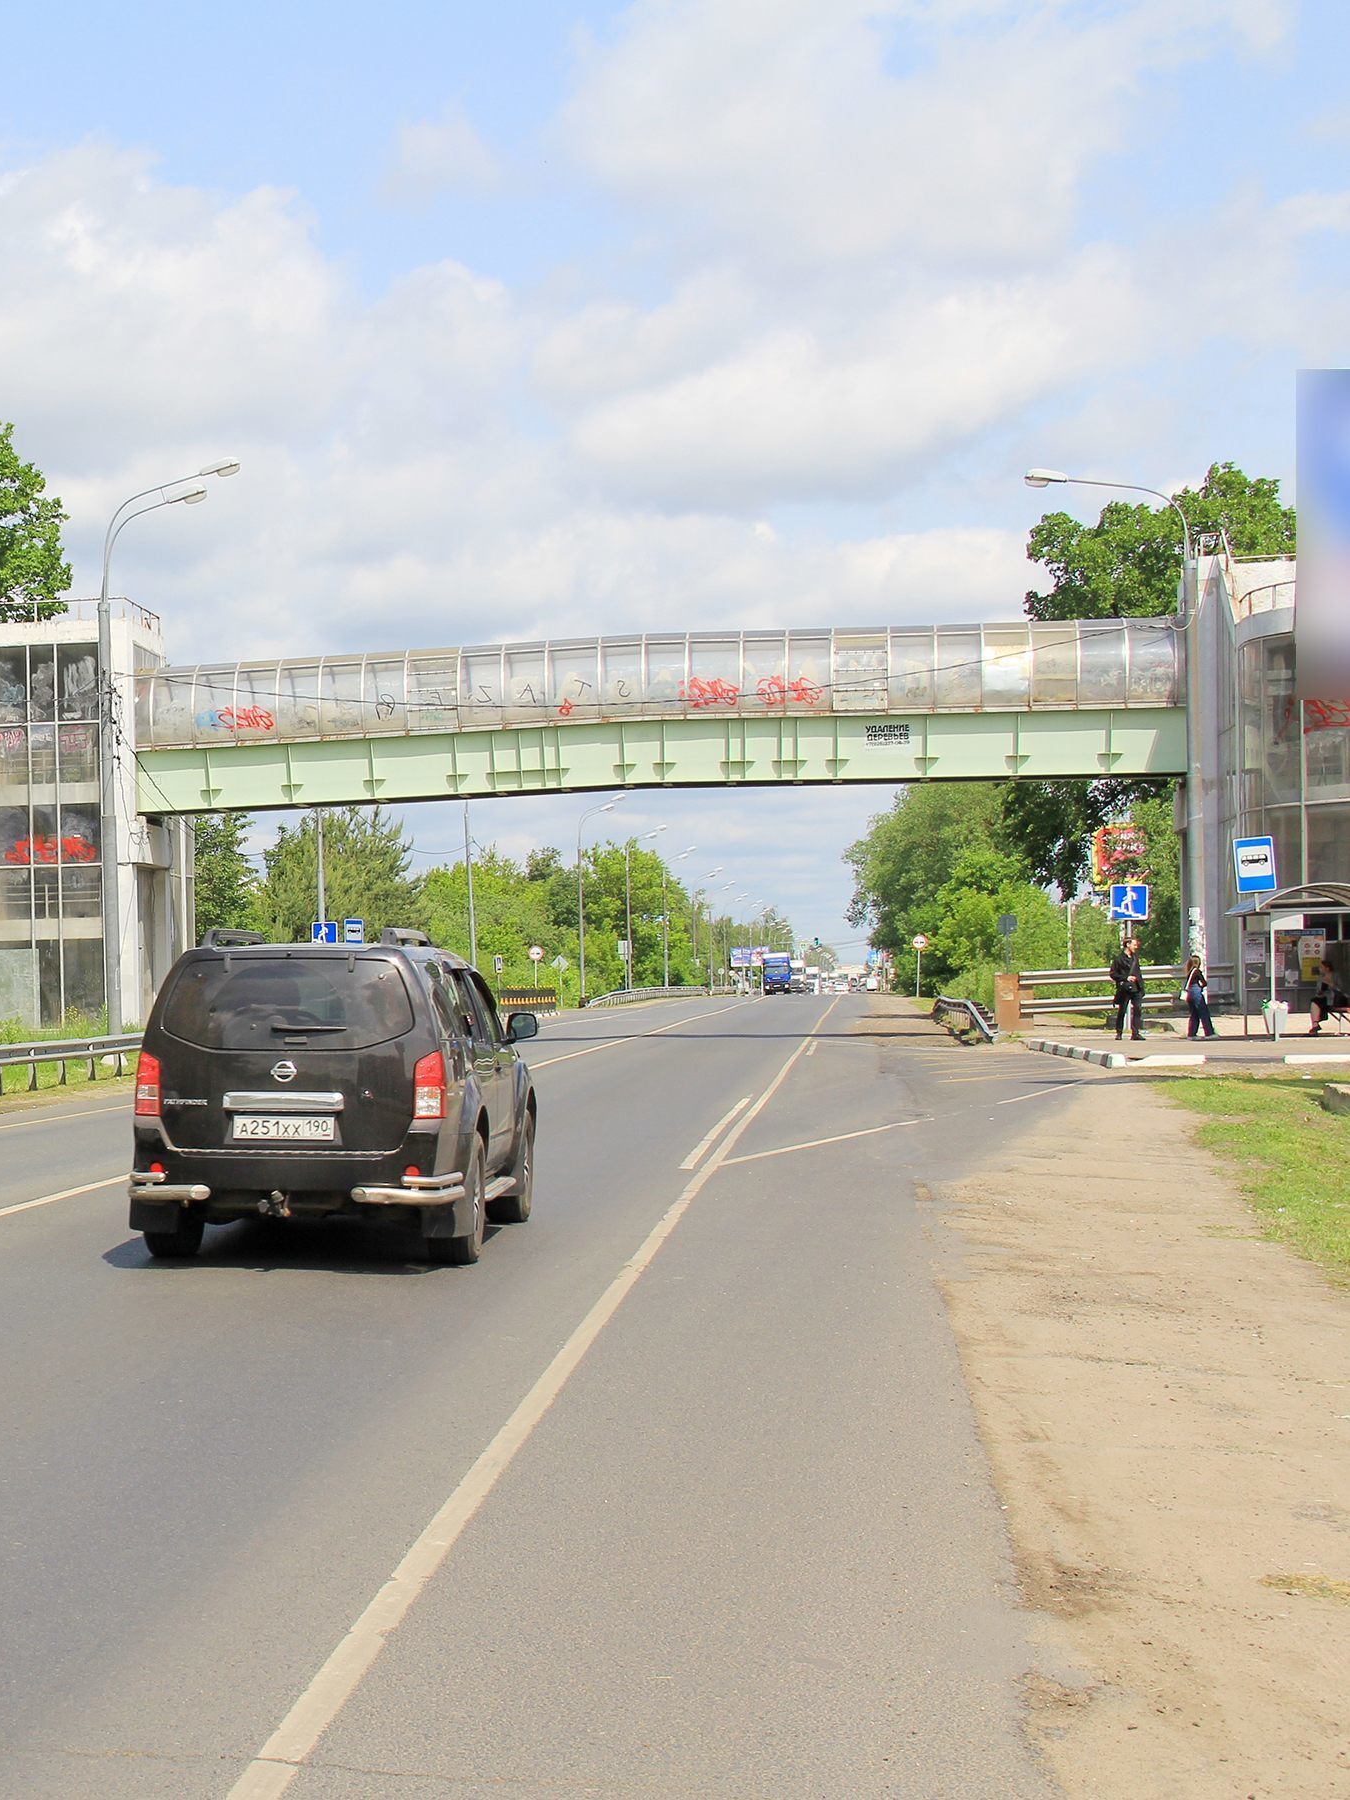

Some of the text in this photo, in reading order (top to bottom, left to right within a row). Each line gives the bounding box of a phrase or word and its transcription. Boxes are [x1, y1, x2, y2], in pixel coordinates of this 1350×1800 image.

[865, 724, 910, 733] УДАЛЕНИЕ
[866, 732, 910, 741] ДЕРЕВЬЕВ
[305, 1119, 329, 1133] 190
